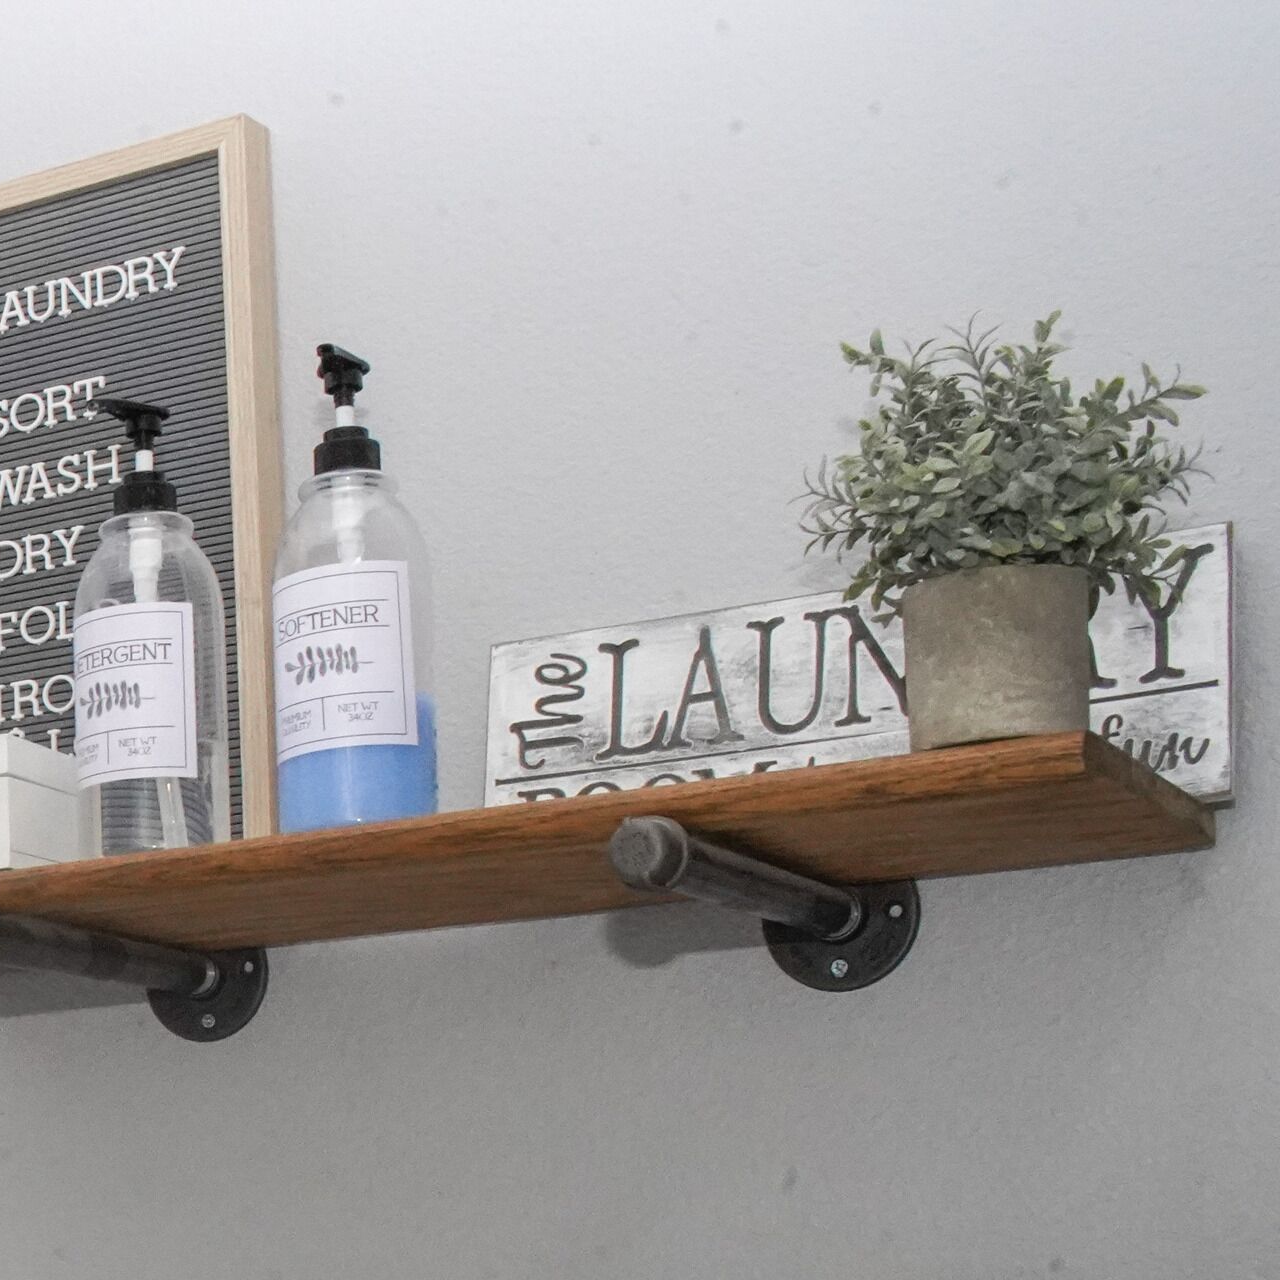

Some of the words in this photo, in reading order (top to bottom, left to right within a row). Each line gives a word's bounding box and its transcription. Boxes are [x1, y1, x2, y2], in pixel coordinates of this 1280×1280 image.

[77, 642, 172, 673] ETERGENT
[278, 604, 380, 641] SOFTENER
[595, 543, 1214, 762] LAUNY
[509, 652, 589, 771] The
